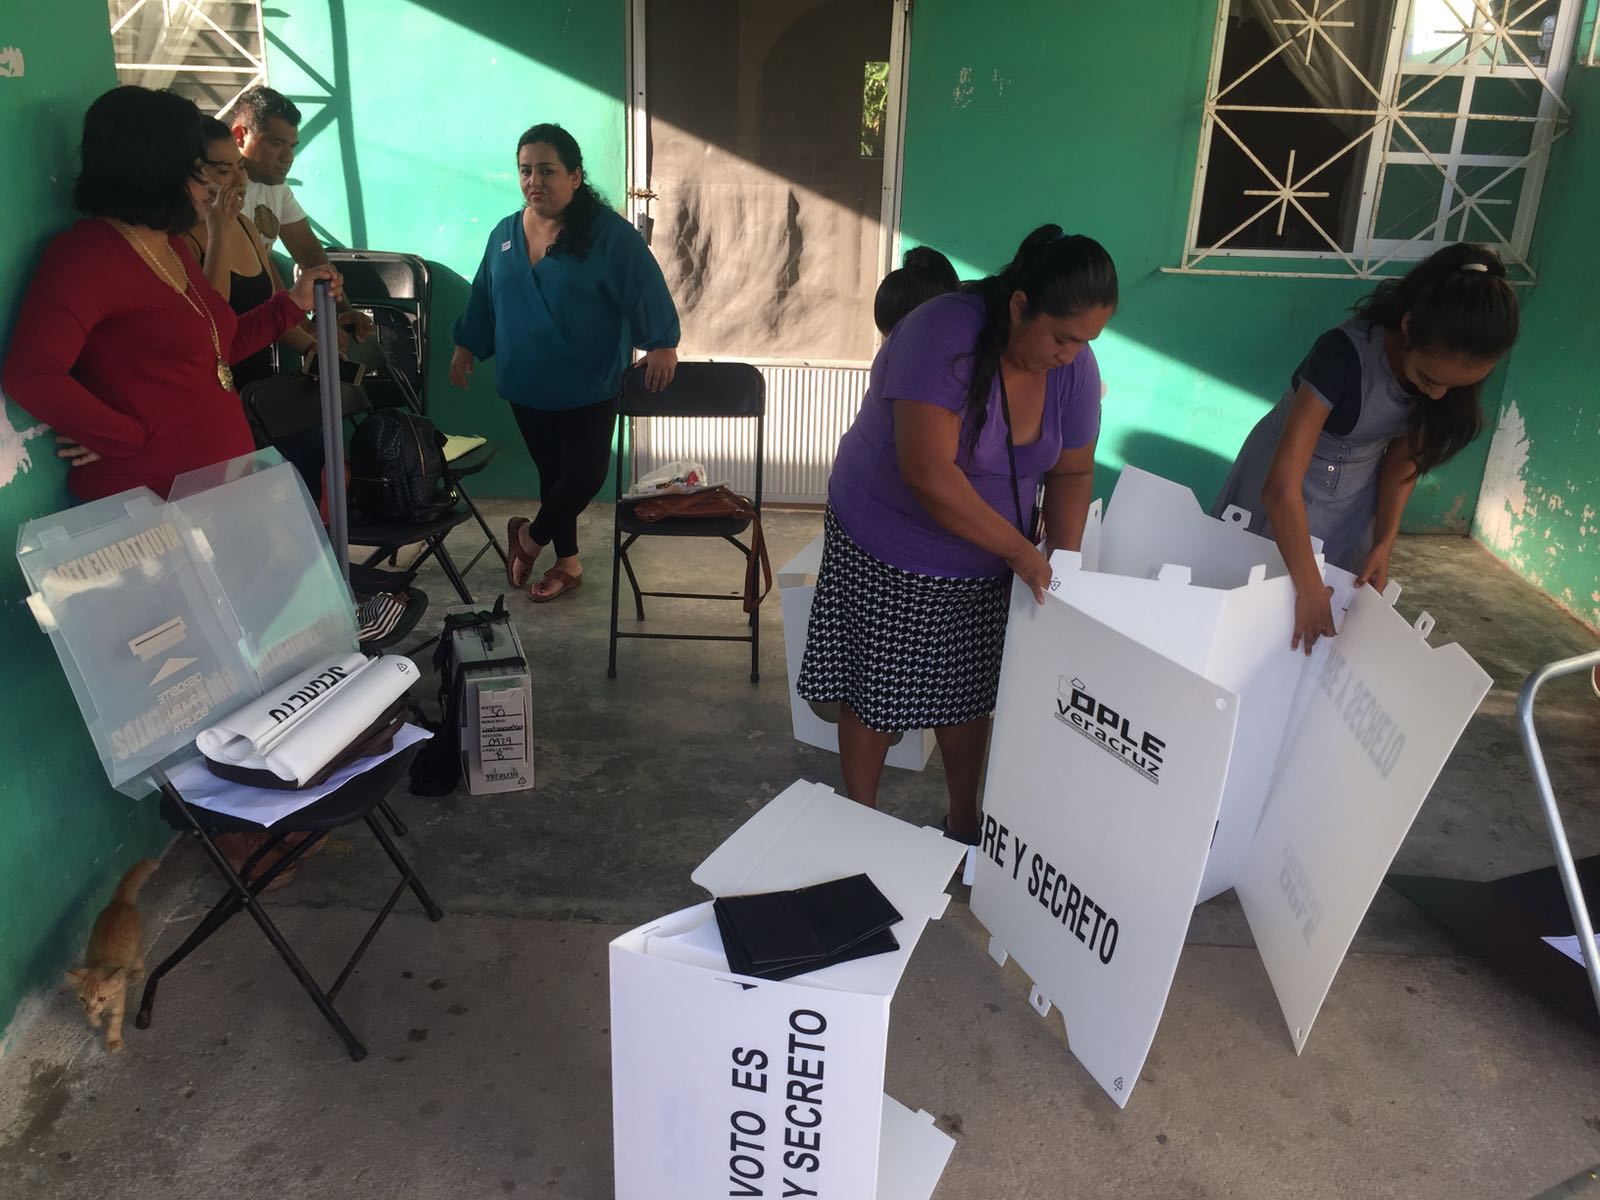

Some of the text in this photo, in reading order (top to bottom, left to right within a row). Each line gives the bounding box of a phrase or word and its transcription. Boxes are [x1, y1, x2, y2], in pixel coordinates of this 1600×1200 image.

[1056, 698, 1160, 778] Veracruz
[1070, 688, 1167, 764] OPLE
[1013, 836, 1028, 880] Y
[1027, 853, 1119, 965] SECRETO
[729, 1047, 769, 1197] VOTO ES
[782, 1009, 827, 1198] Y SECRETO
